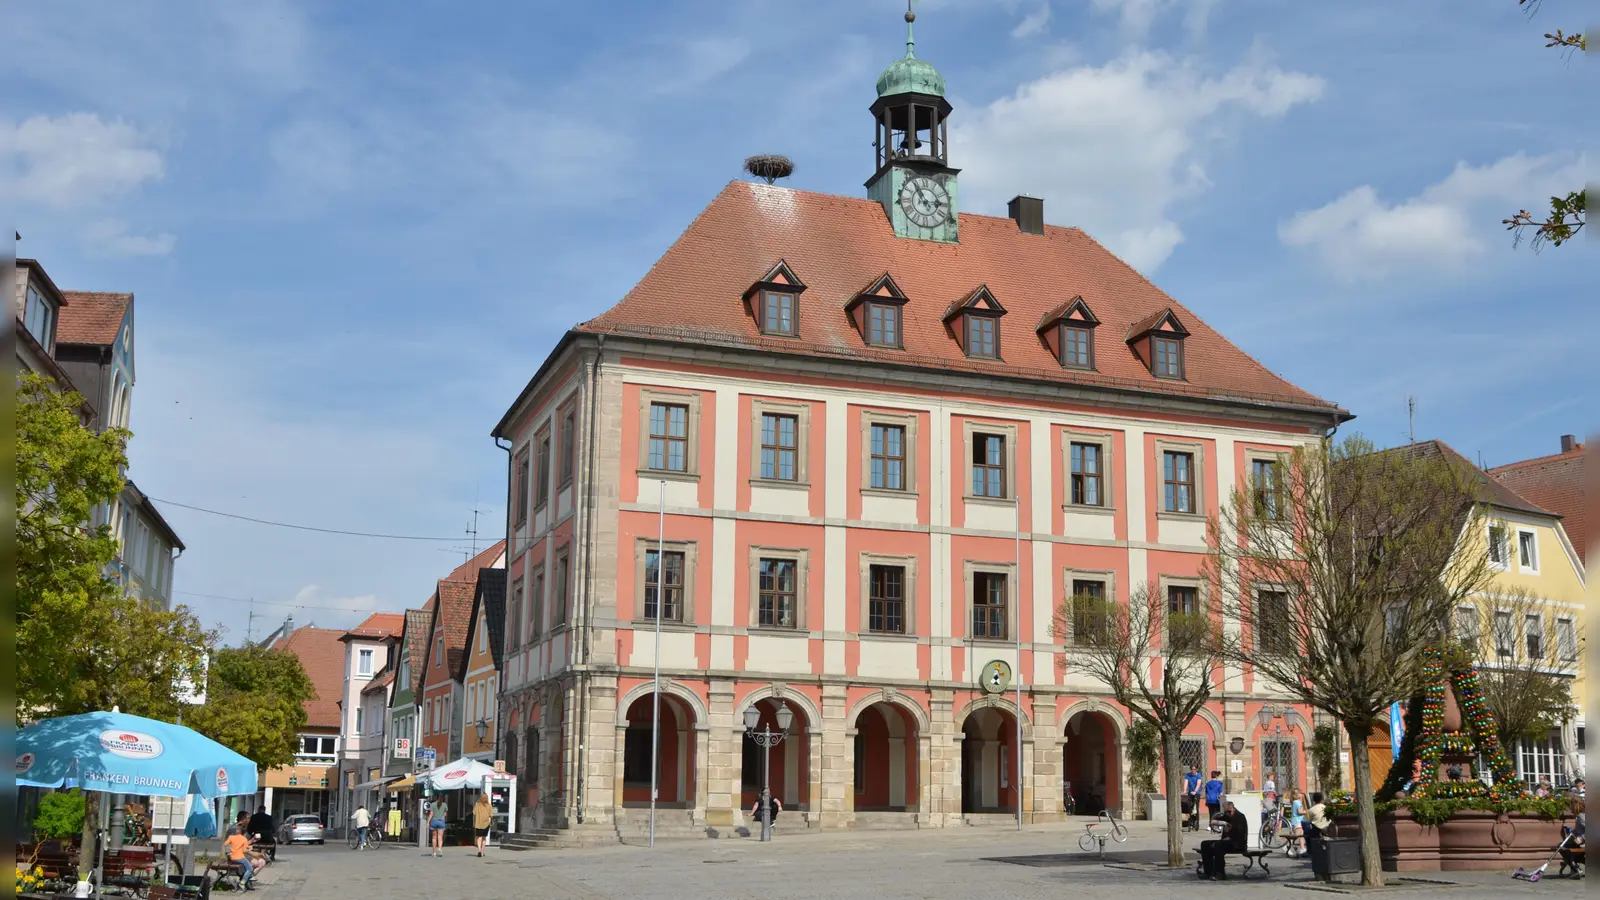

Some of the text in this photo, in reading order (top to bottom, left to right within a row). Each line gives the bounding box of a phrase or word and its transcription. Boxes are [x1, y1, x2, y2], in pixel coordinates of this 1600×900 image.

[397, 740, 408, 749] B6
[84, 771, 182, 790] FRANKEN BRUNNEN
